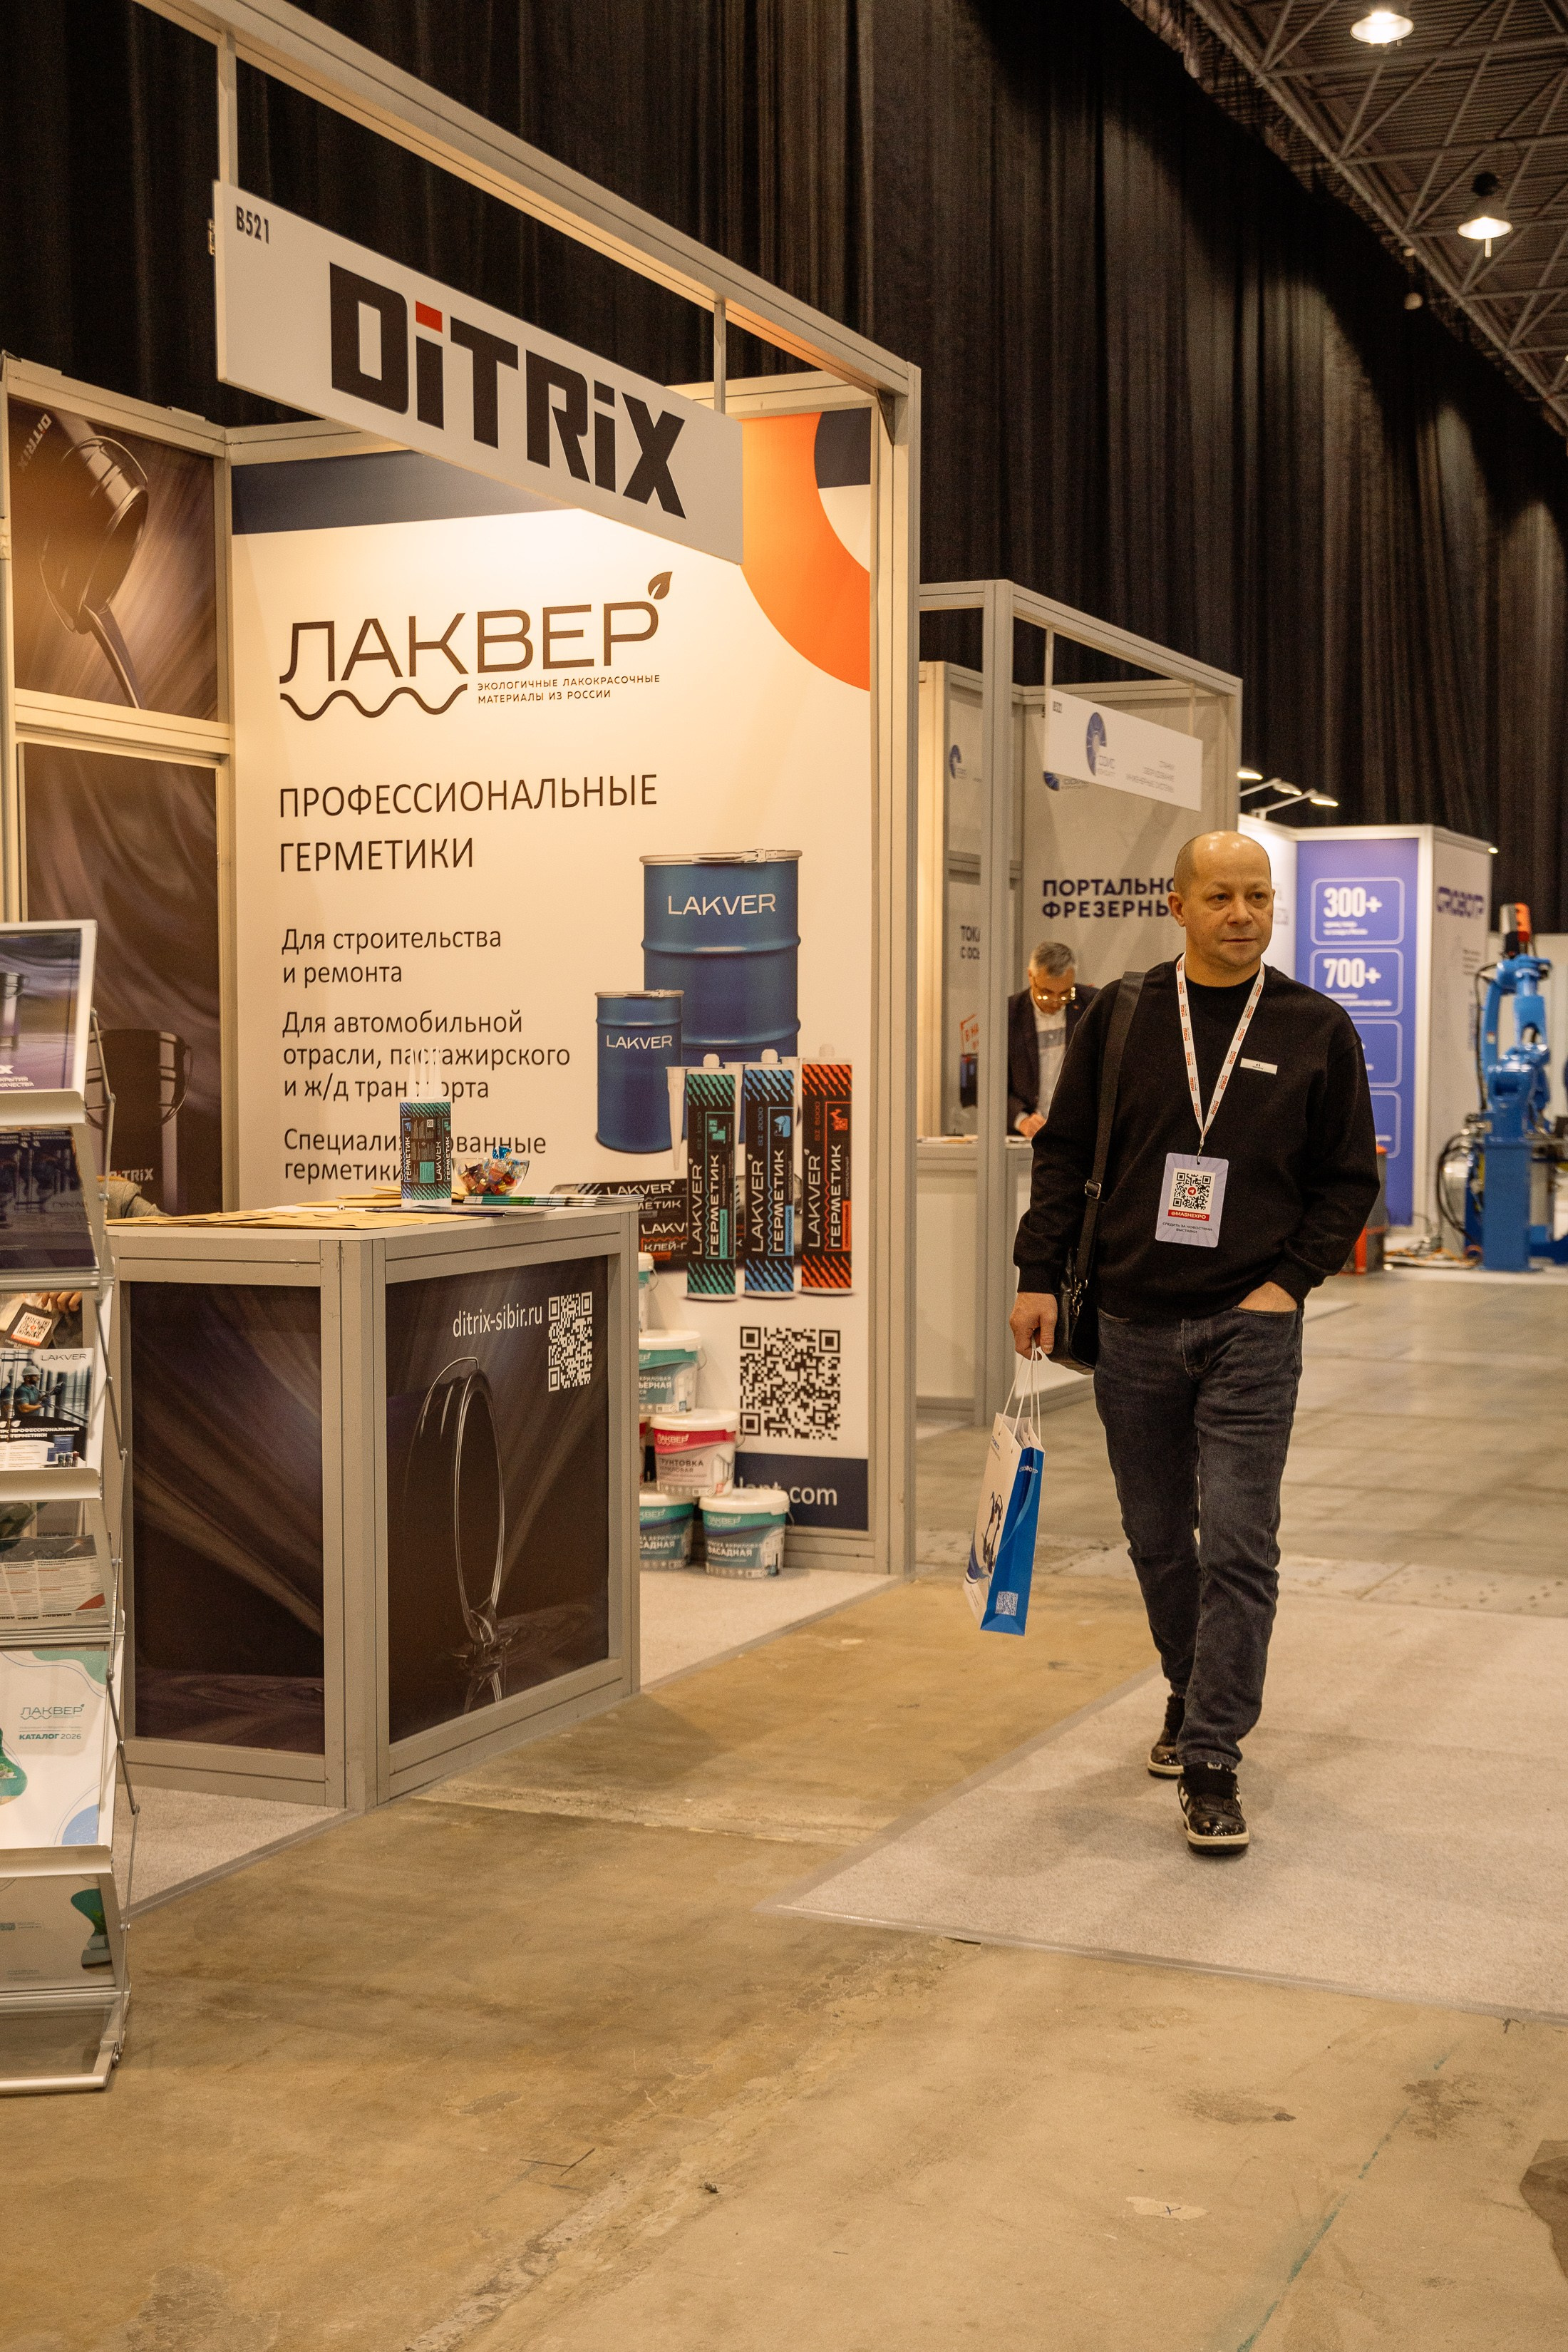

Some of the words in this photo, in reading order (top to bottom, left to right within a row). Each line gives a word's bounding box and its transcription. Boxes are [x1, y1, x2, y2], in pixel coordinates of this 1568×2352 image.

[236, 205, 270, 244] B521
[279, 601, 659, 684] ЛАКВЕР
[478, 679, 558, 691] ЭКОЛОГИЧНЫЕ
[562, 674, 660, 686] ЛАКОКРАСОЧНЫЕ
[478, 692, 544, 704] МАТЕРИАЛЫ
[549, 691, 562, 701] ИЗ
[567, 689, 611, 700] РОССИИ
[279, 774, 658, 818] ПРОФЕССИОНАЛЬНЫЕ
[280, 837, 474, 872] ГЕРМЕТИКИ
[668, 893, 776, 916] LAKVER
[1323, 887, 1383, 918] 300+
[282, 929, 325, 954] Для
[333, 930, 501, 954] строительства
[284, 966, 296, 983] и
[304, 965, 402, 988] ремонта
[1323, 958, 1382, 989] 700+
[282, 1011, 326, 1038] Для
[334, 1010, 522, 1033] автомобильной
[607, 1036, 673, 1049] LAKVER
[284, 1048, 381, 1069] отрасли,
[285, 1080, 296, 1097] и
[304, 1074, 349, 1101] ж/д
[356, 1080, 489, 1103] транорта
[607, 1184, 672, 1195] LAKVER
[711, 1155, 719, 1255] ГЕРМЕТИК
[774, 1150, 784, 1252] ГЕРМЕТИК
[808, 1156, 820, 1247] LAKVER
[831, 1144, 841, 1247] ГЕРМЕТИК
[692, 1165, 702, 1255] LAKVER
[752, 1161, 764, 1252] LAKVER
[642, 1222, 688, 1234] LAKV
[453, 1305, 542, 1338] ditrix-sibir.ru
[20, 1706, 83, 1715] ЛАКВЕР
